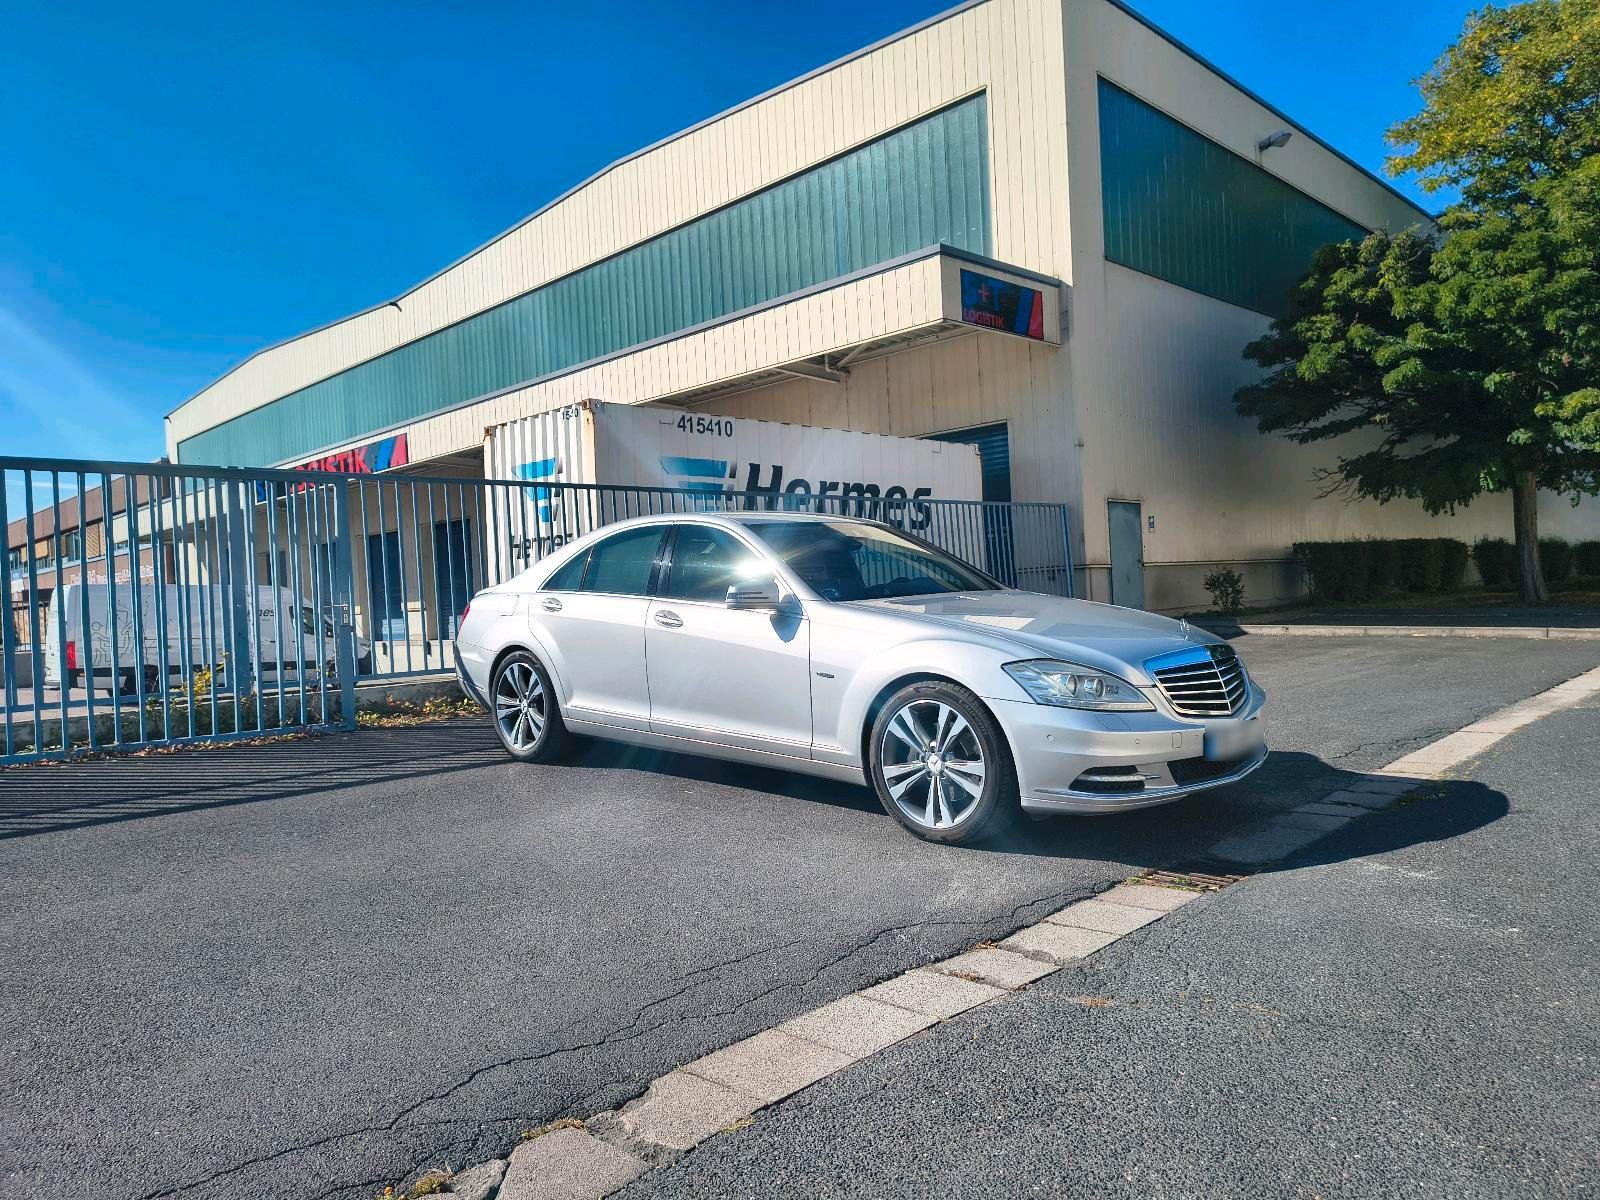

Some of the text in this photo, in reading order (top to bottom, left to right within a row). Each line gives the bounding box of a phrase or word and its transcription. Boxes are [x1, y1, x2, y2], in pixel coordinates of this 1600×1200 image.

[963, 308, 1005, 329] LOGISTIK
[677, 415, 733, 437] 415410
[742, 462, 932, 531] Hermes
